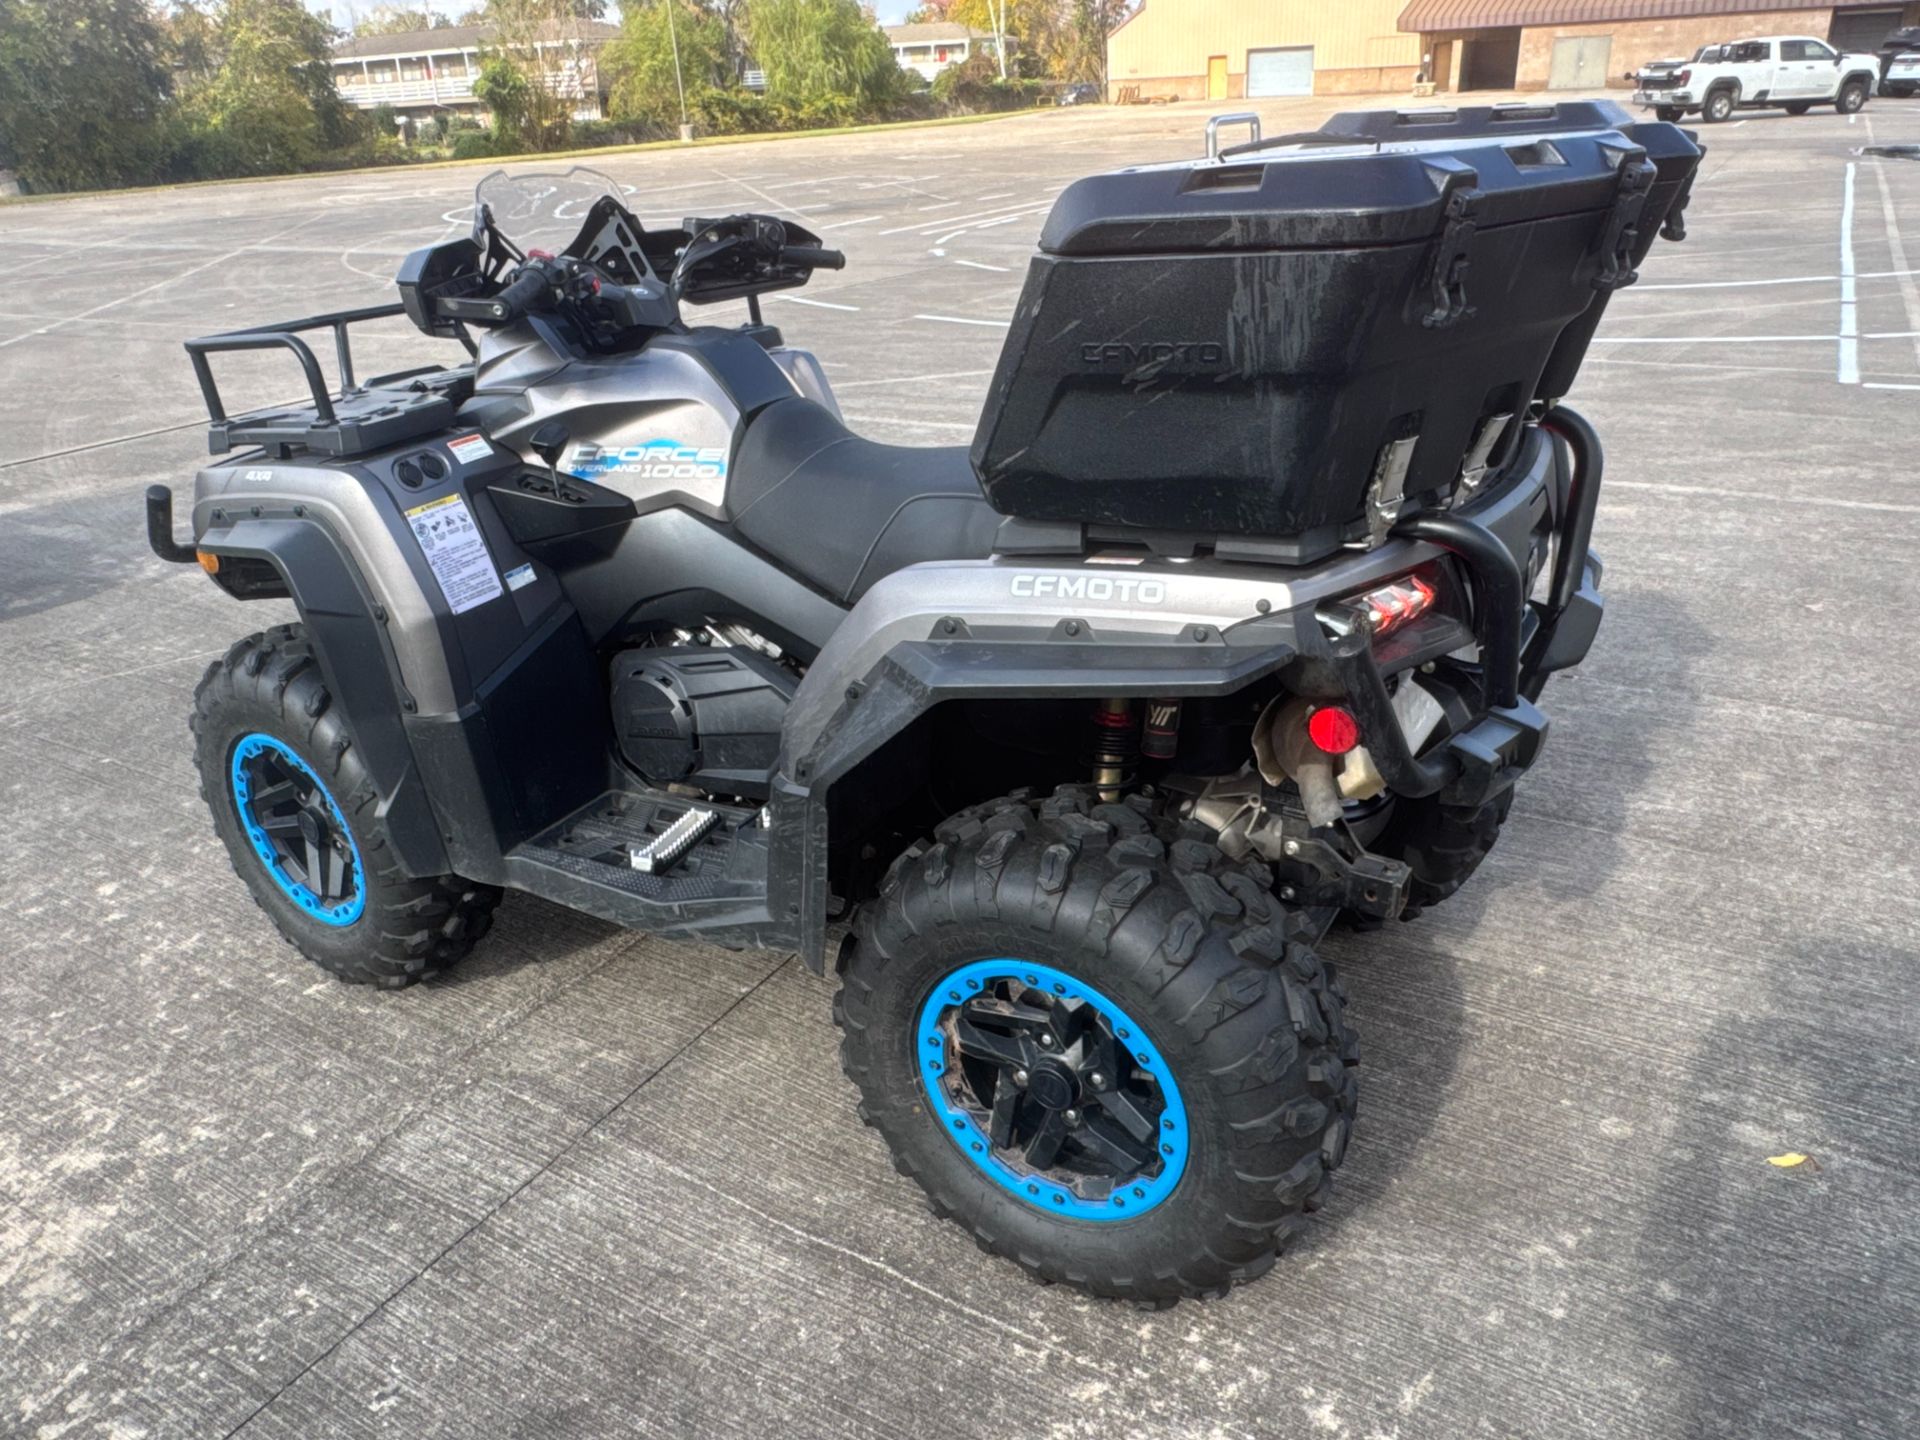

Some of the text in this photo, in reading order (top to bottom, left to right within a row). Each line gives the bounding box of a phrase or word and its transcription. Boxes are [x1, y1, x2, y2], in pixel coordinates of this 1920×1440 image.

[1081, 341, 1222, 363] CFMOTO
[571, 446, 727, 462] CFORCE
[567, 463, 721, 479] OVERLAND 1000
[1010, 574, 1165, 604] CFMOTO
